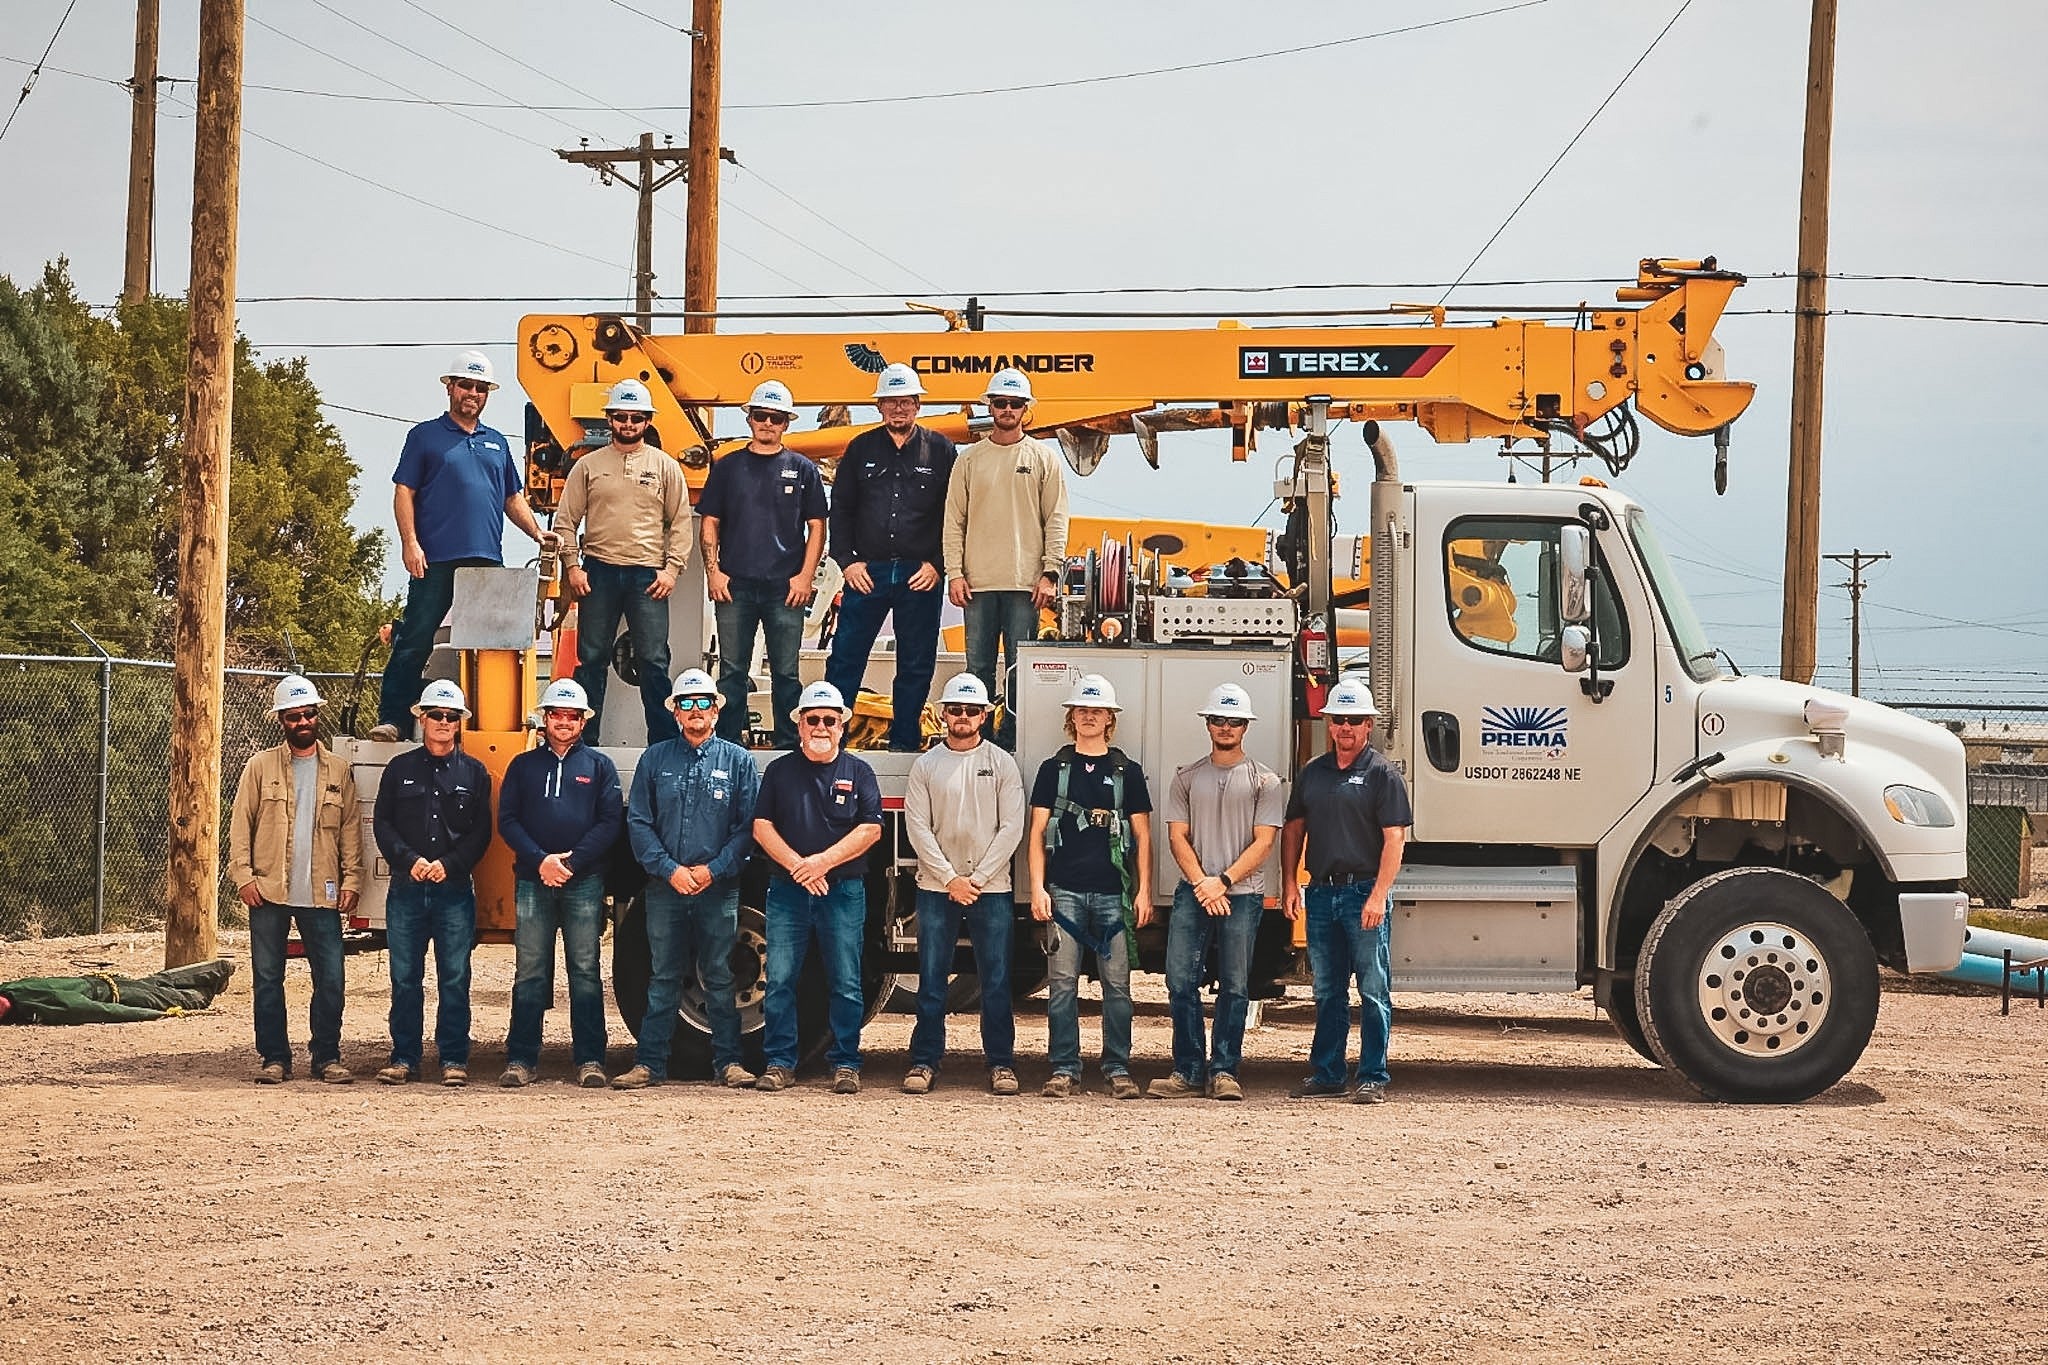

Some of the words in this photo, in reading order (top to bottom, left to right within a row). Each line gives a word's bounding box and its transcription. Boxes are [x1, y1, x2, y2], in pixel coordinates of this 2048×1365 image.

[911, 354, 1095, 374] COMMANDER
[1665, 685, 1672, 703] 5
[1481, 732, 1567, 747] PREMA
[1465, 766, 1508, 779] USDOT
[1512, 768, 1560, 780] 2862248
[1564, 768, 1581, 780] NE
